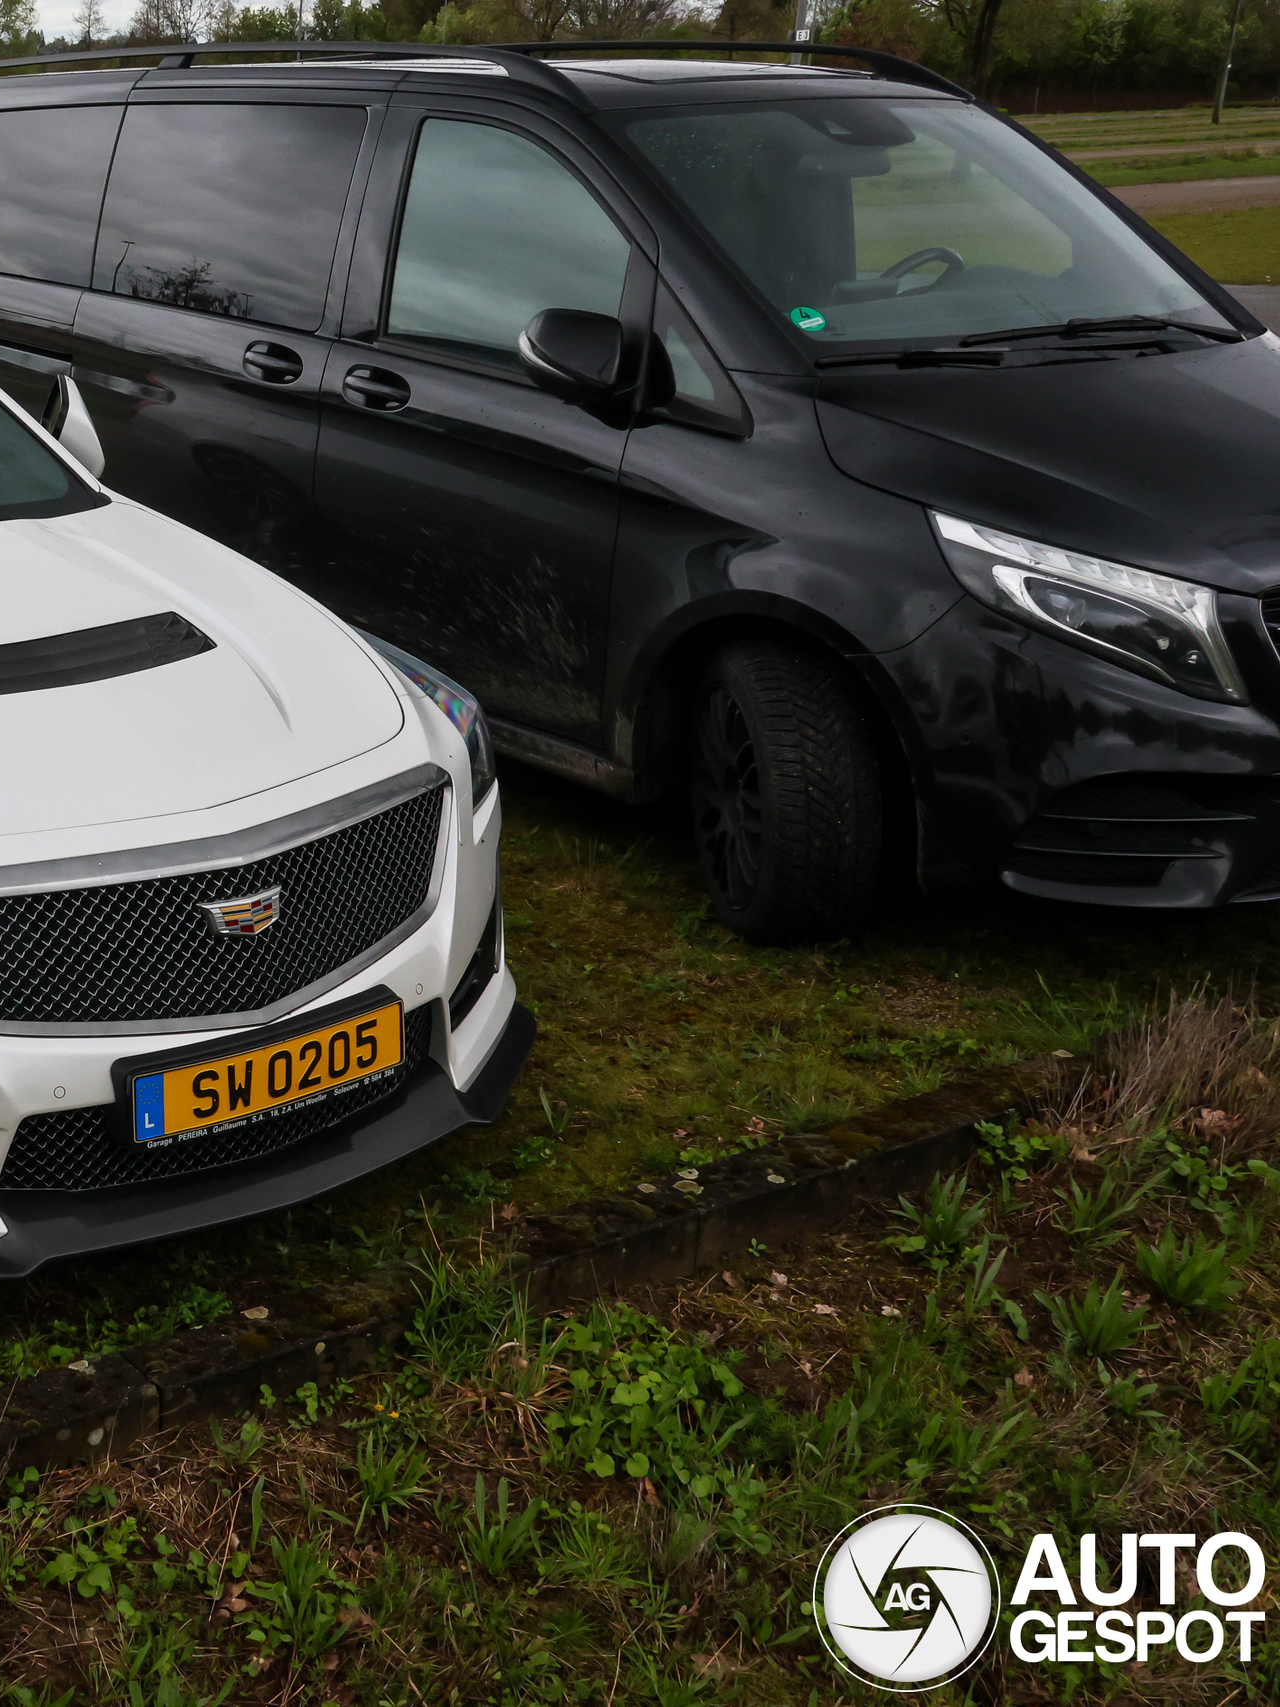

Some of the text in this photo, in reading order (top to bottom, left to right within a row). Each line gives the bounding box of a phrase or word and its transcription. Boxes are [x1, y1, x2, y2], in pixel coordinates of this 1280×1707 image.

[799, 308, 811, 319] 4
[192, 1018, 378, 1118] SW 0205
[144, 1112, 155, 1129] L
[146, 1137, 173, 1149] Garage
[178, 1129, 208, 1142] PEREIRA
[212, 1119, 247, 1134] Guillaume
[251, 1113, 266, 1123] S.A.
[281, 1104, 294, 1115] Z.A.
[294, 1101, 305, 1110] Um
[333, 1082, 360, 1096] Soleuvre
